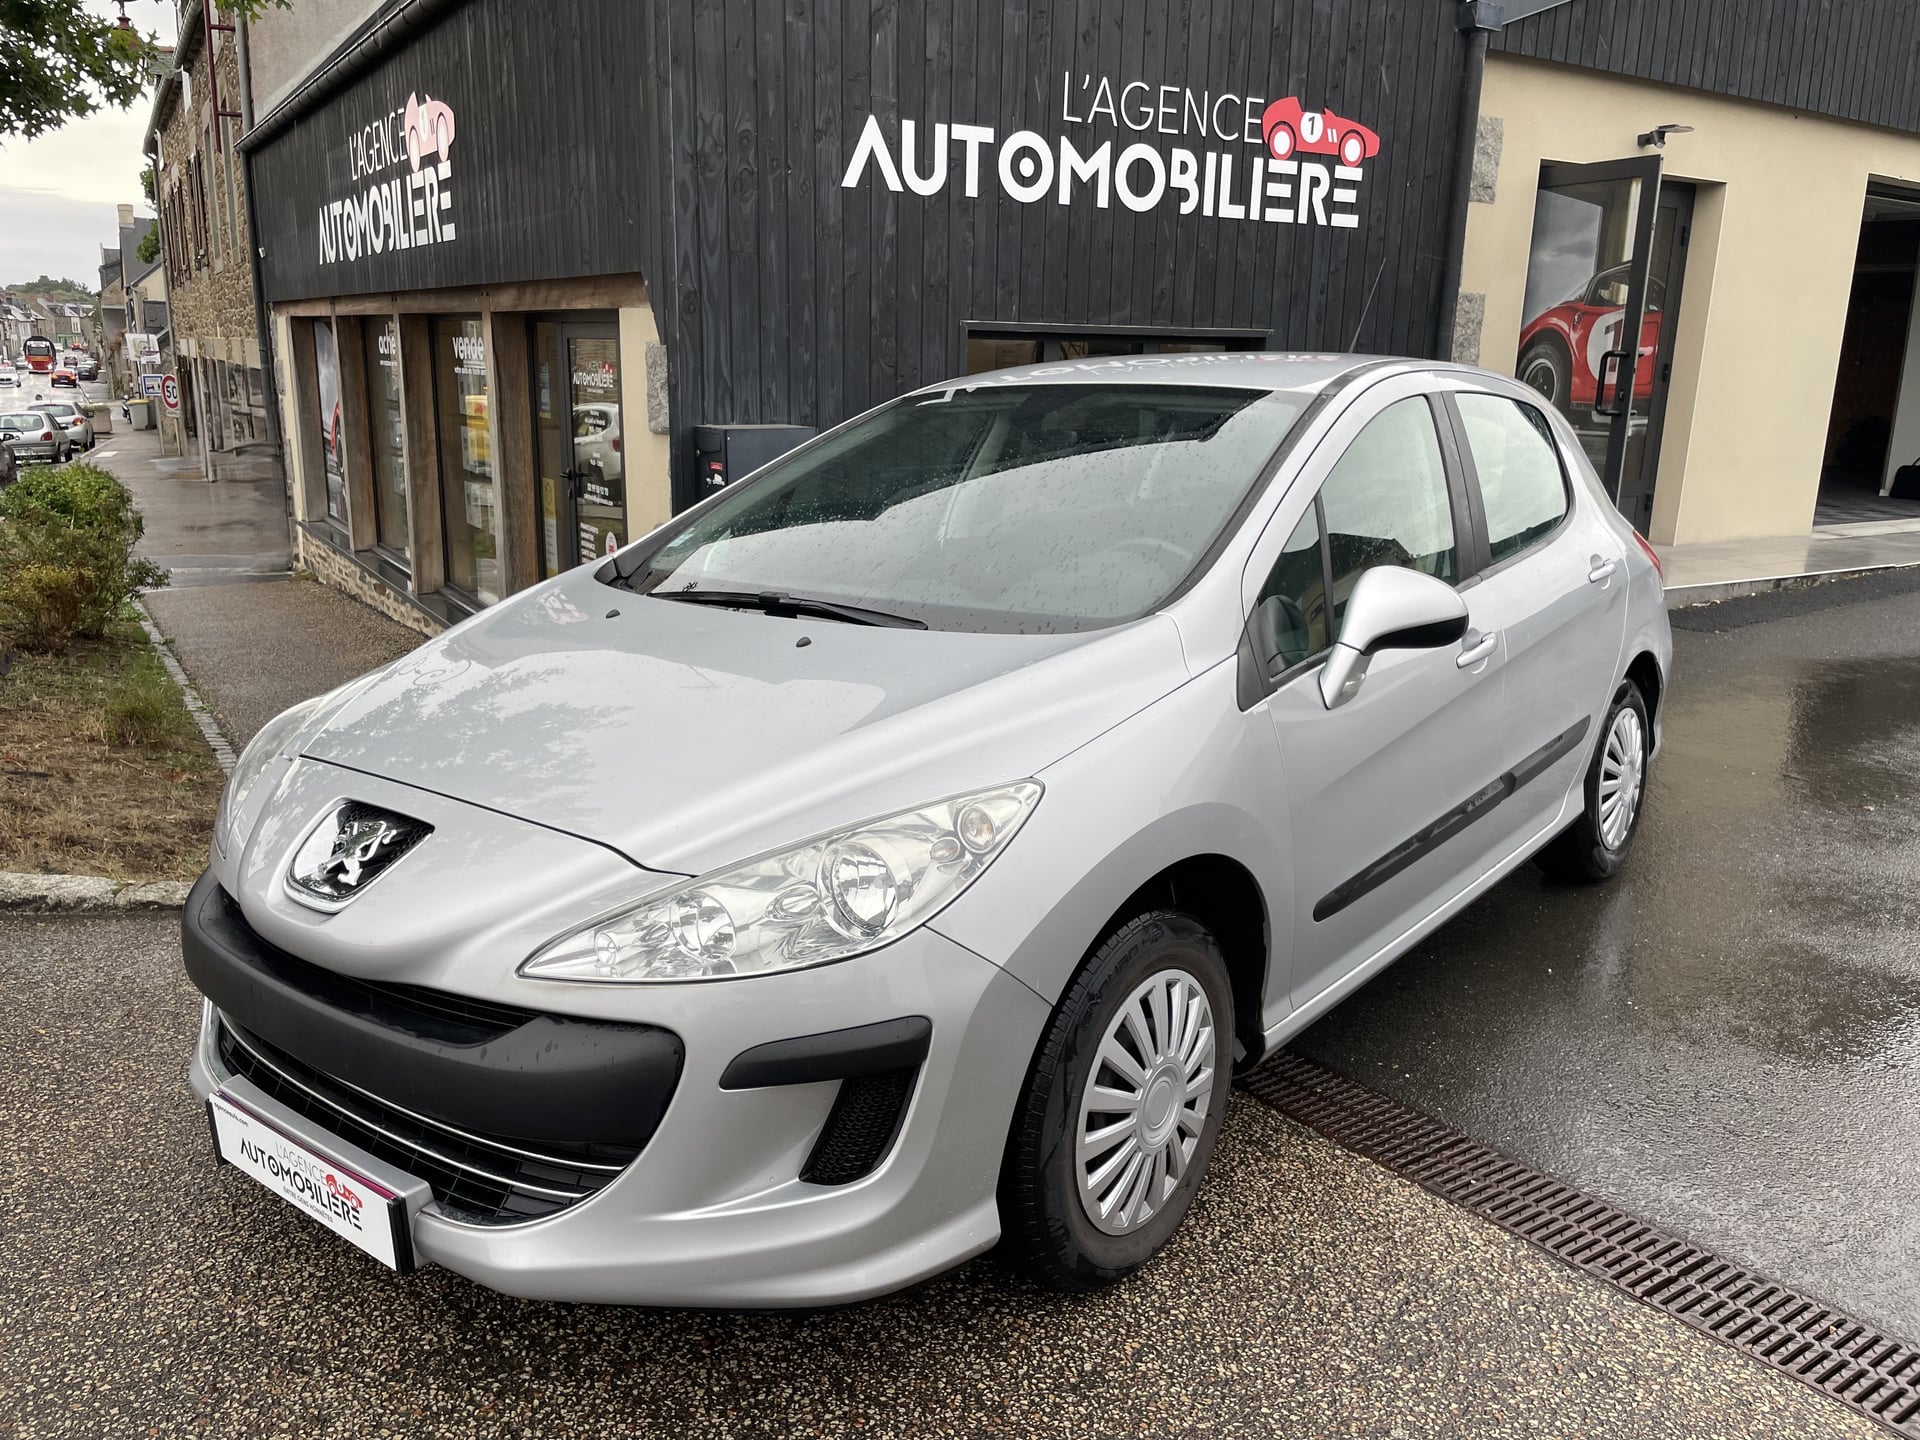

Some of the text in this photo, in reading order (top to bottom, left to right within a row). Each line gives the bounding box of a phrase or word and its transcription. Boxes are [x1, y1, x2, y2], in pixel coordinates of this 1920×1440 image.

[1063, 71, 1265, 144] L'AGENCE
[349, 108, 408, 181] L'AGENCE
[166, 385, 178, 399] 50
[276, 1142, 327, 1185] L'AGENCE
